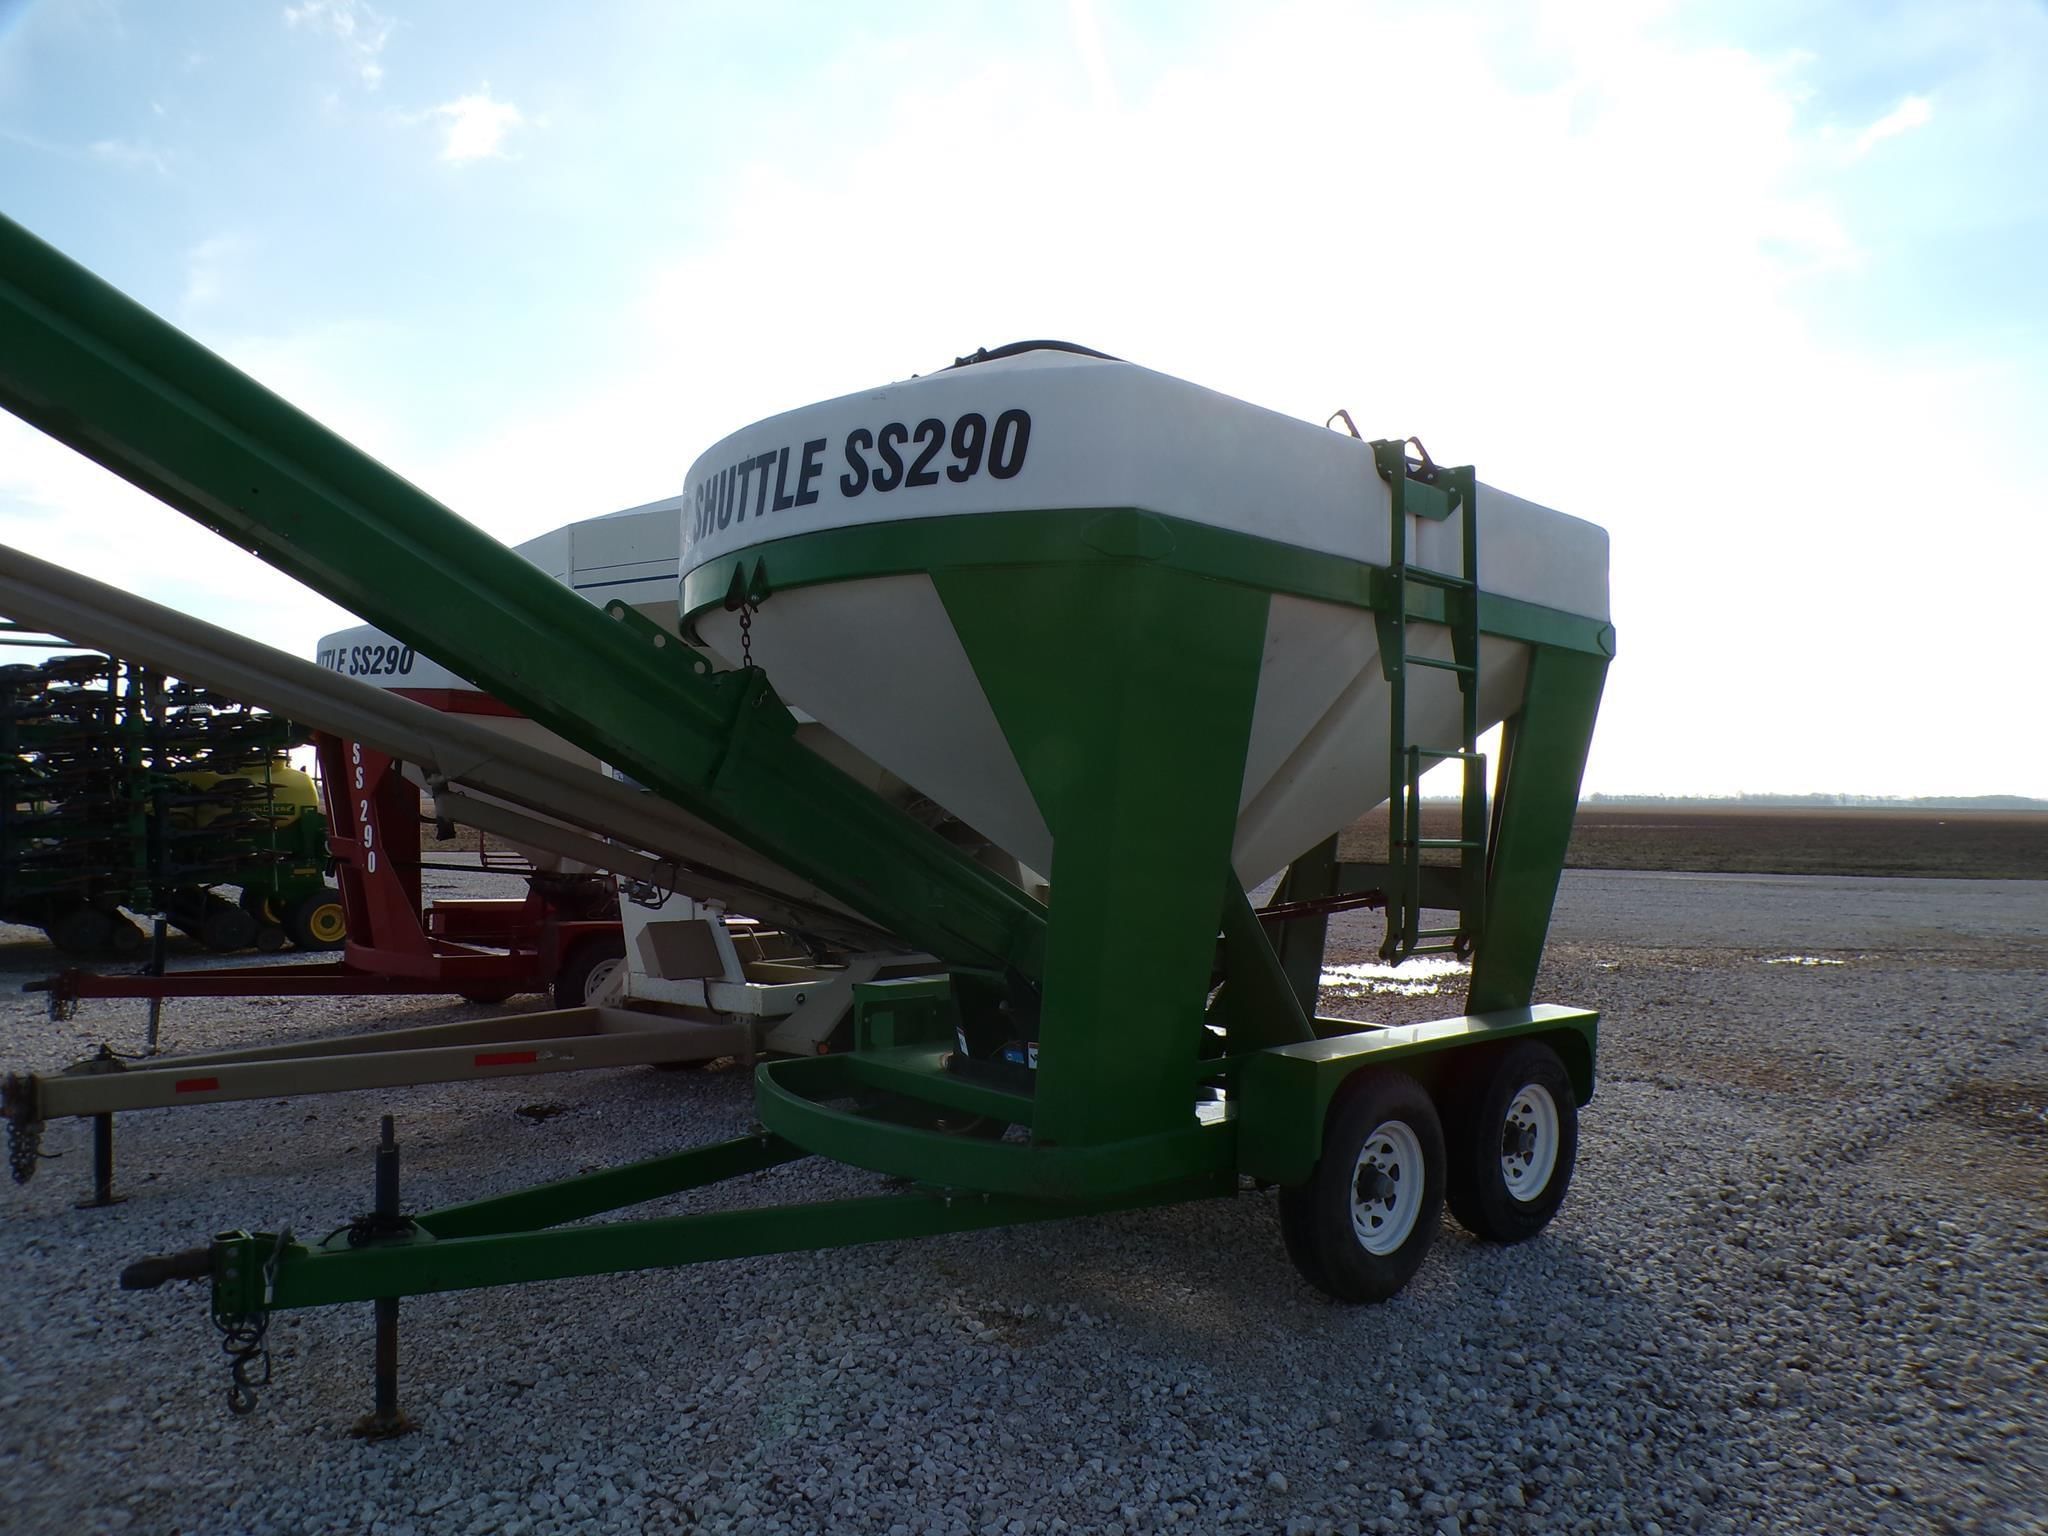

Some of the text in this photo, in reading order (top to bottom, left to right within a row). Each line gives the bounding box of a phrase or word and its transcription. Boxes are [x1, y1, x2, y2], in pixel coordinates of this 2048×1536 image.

[693, 437, 827, 544] SHUTTLE
[840, 408, 1031, 498] SS290
[349, 645, 415, 675] SS290
